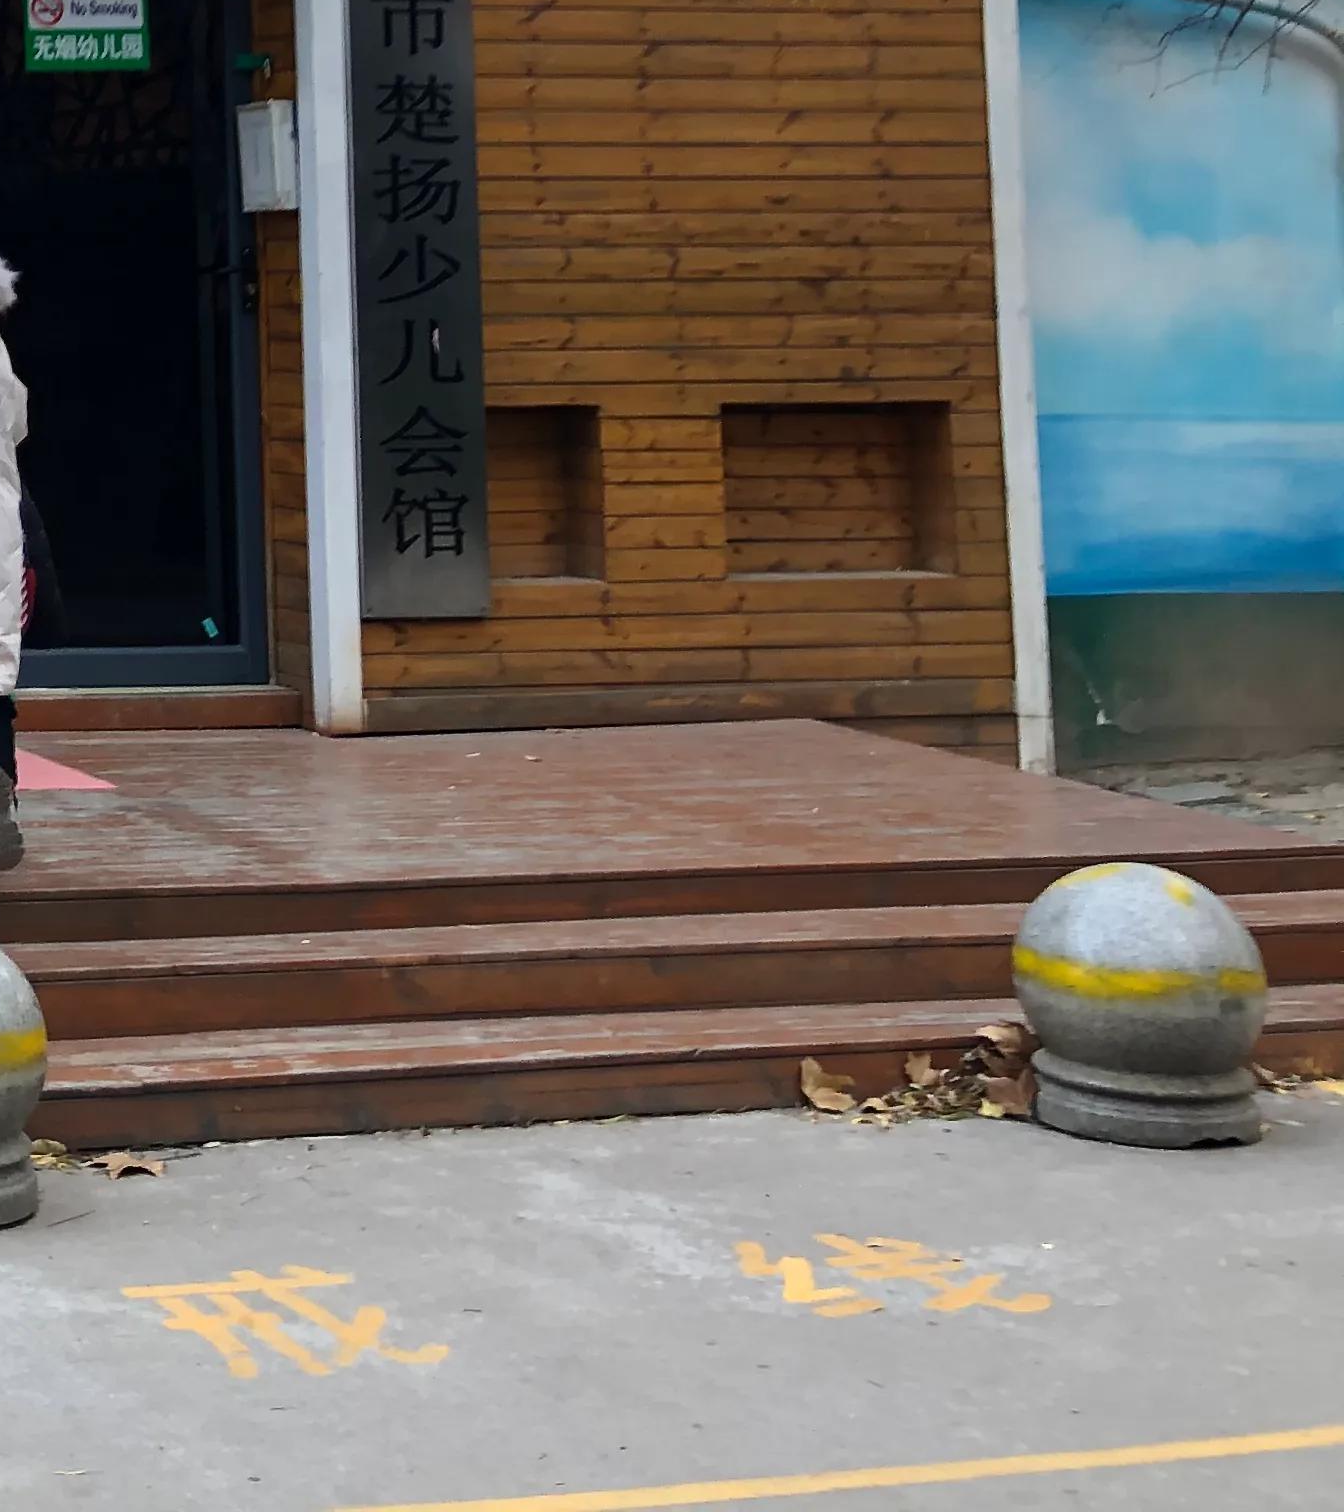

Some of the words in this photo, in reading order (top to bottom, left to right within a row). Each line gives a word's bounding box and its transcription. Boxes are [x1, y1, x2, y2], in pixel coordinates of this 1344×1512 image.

[33, 33, 144, 61] 无烟幼儿园
